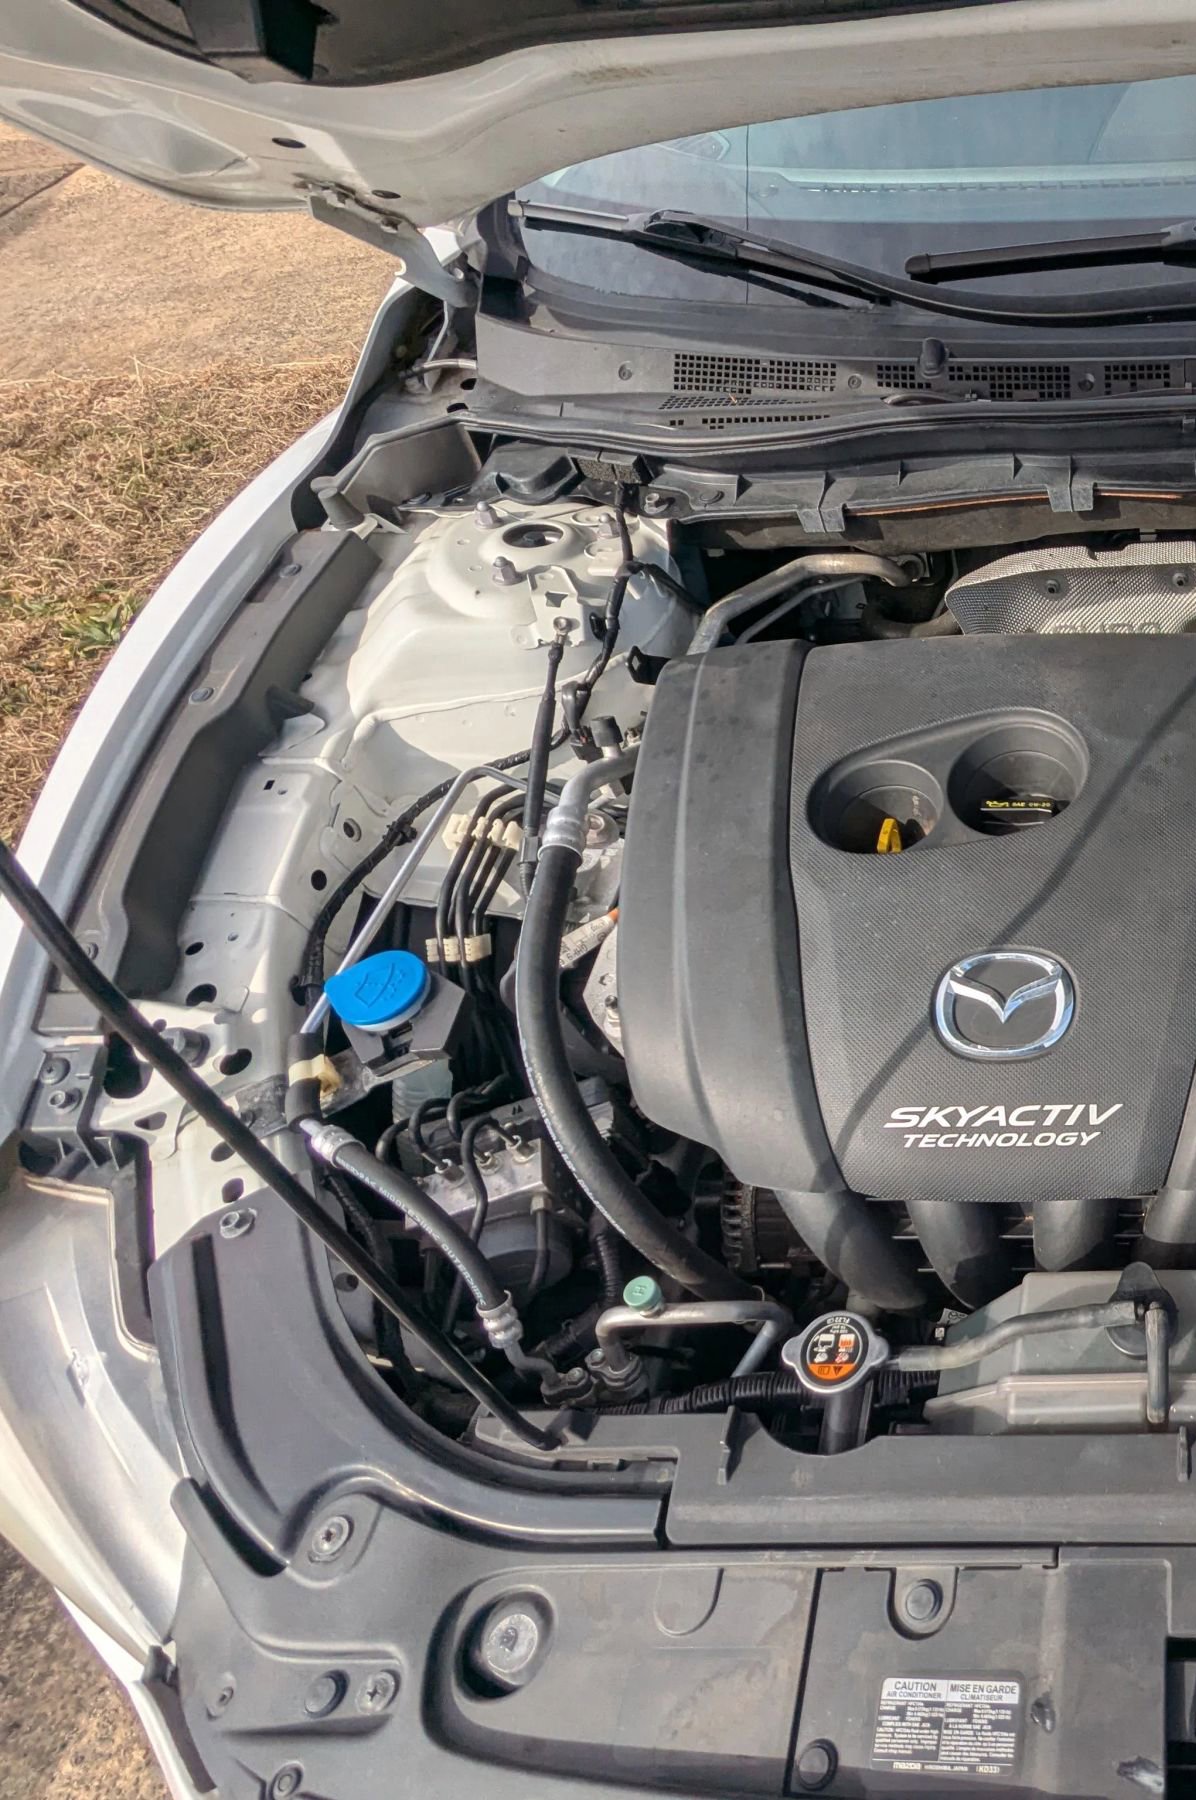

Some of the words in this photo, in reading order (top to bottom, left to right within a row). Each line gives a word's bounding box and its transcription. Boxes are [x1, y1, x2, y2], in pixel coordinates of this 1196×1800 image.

[883, 1103, 1124, 1128] SKYACTIV
[904, 1132, 1101, 1148] TECHNOLOGY
[894, 1681, 936, 1692] CAUTION
[950, 1684, 970, 1692] MISE
[972, 1685, 985, 1693] EN
[986, 1685, 1016, 1694] GARDE
